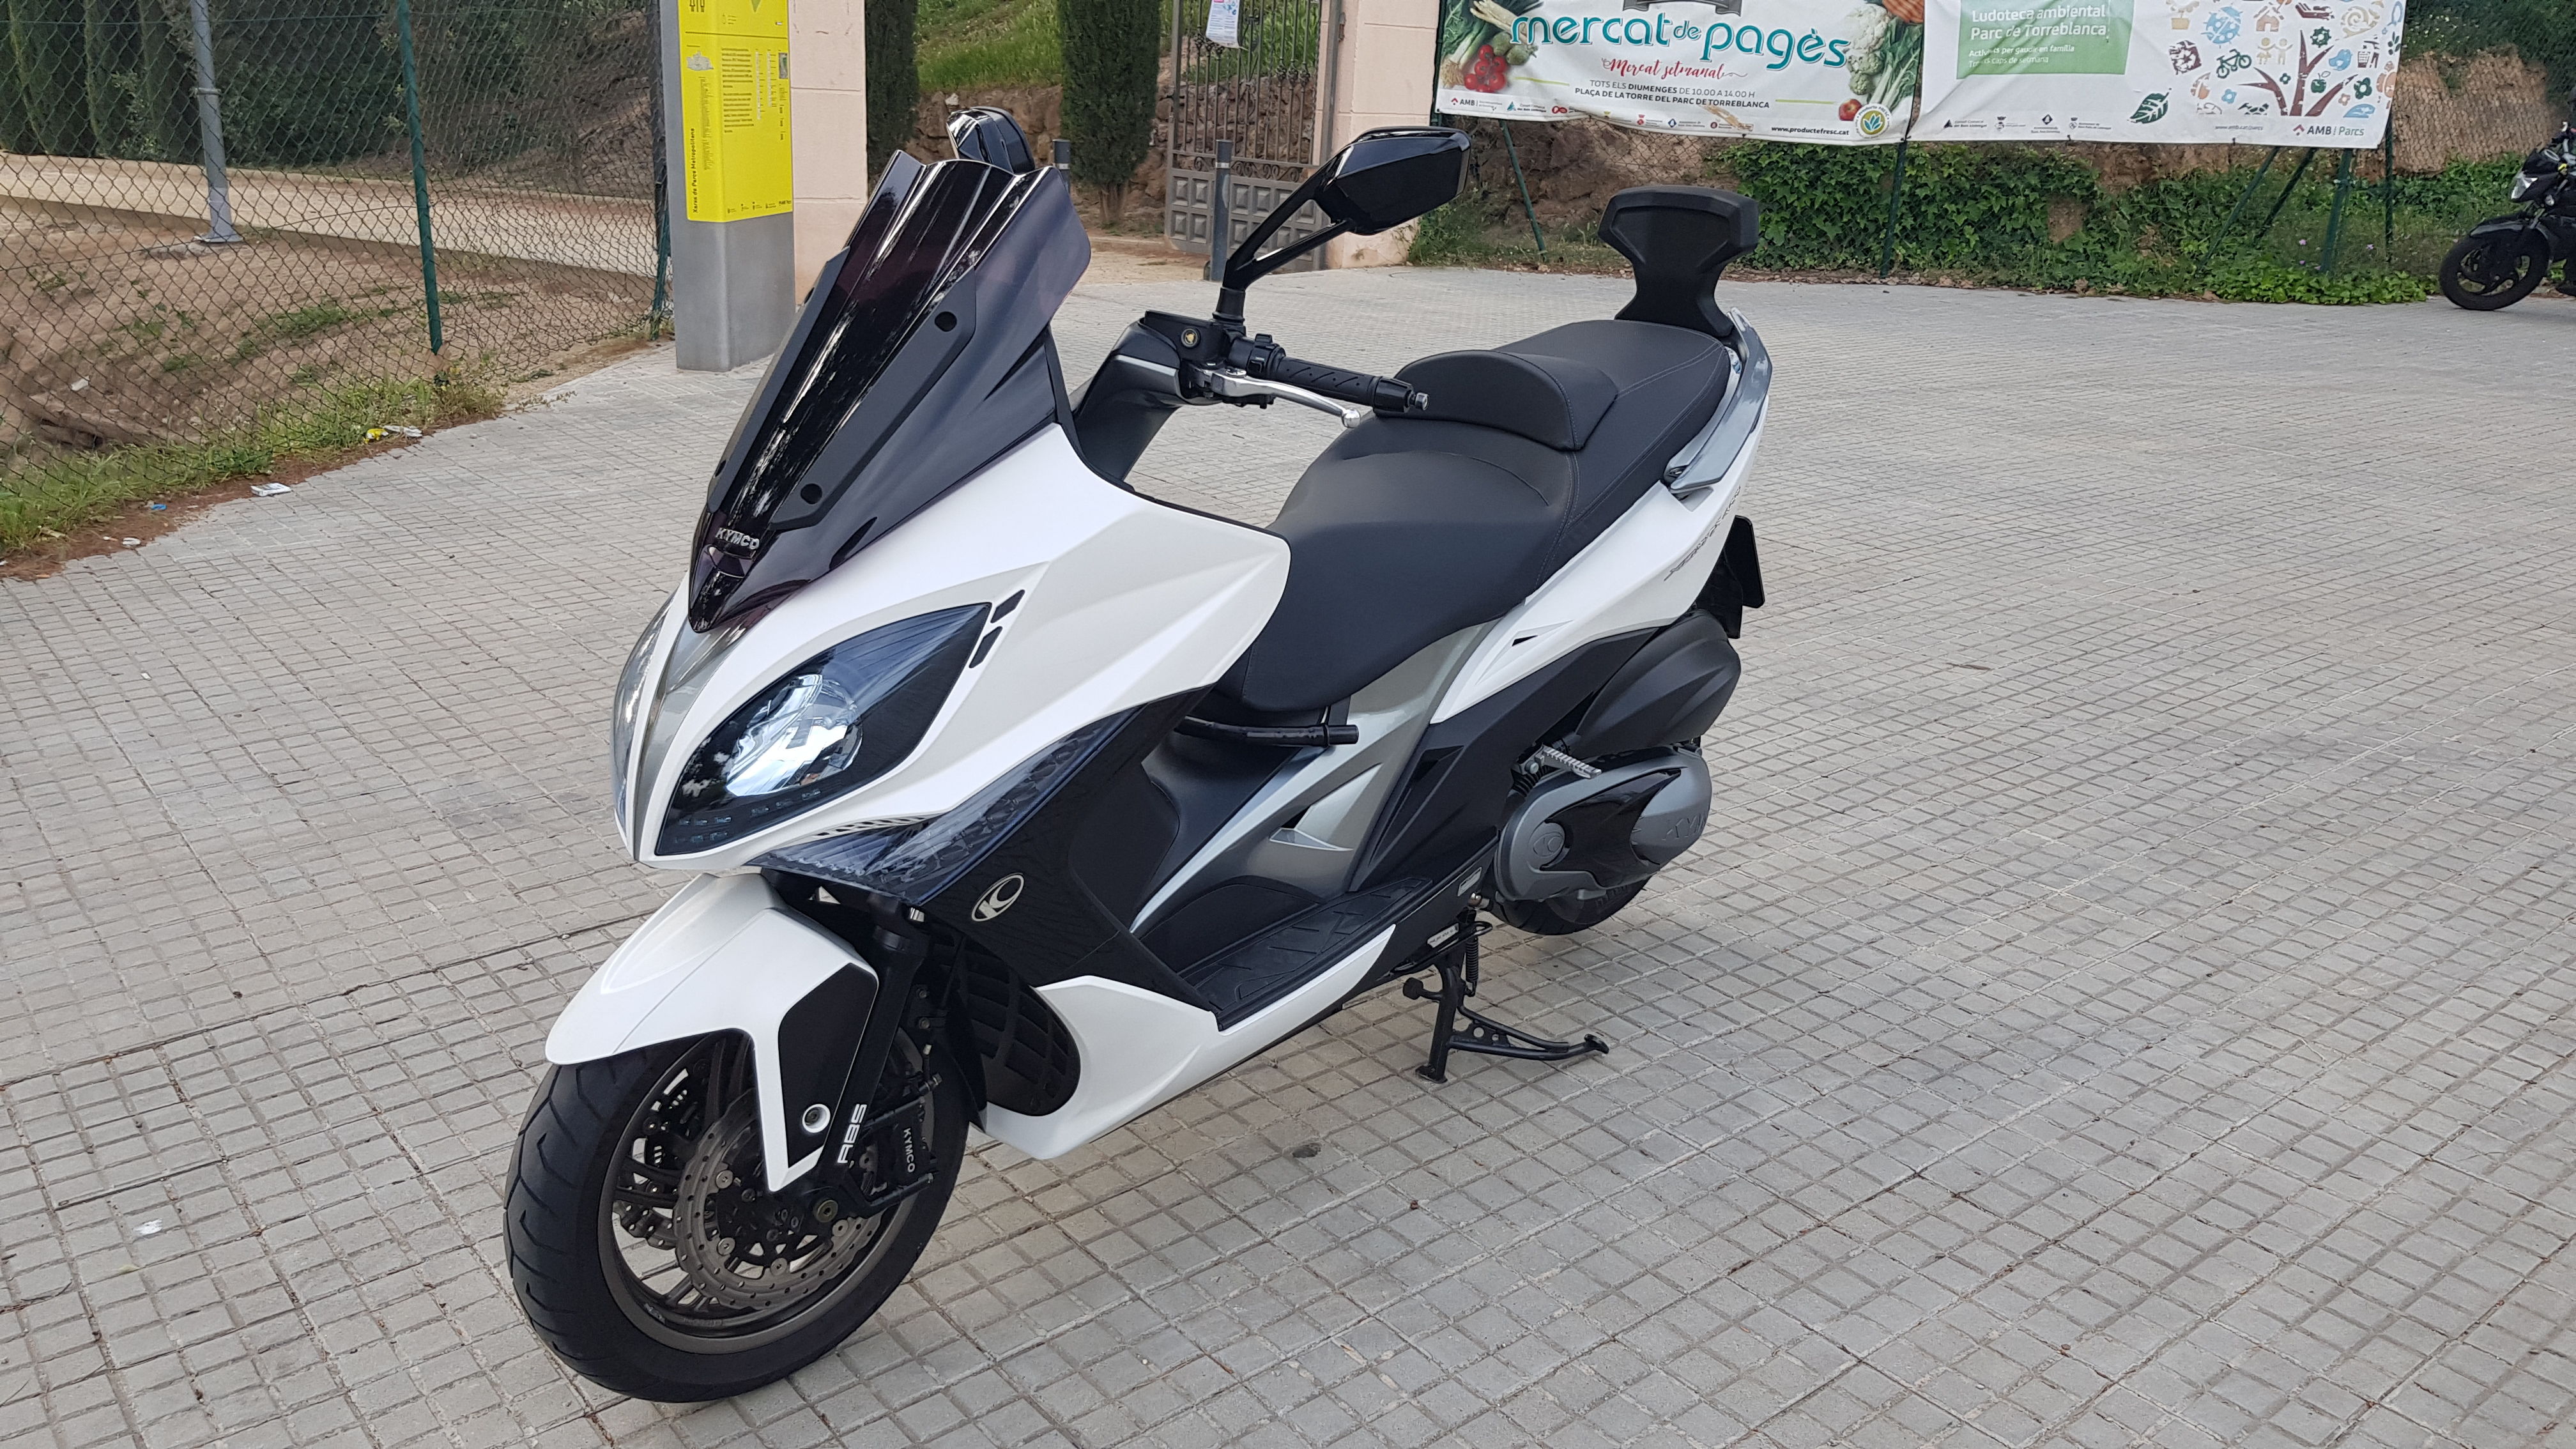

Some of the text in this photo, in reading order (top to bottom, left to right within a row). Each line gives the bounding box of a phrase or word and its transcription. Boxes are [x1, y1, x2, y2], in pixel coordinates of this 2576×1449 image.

[1972, 4, 2106, 22] Ludoteca ambiental
[1512, 12, 1850, 70] mercat de pagès
[1970, 22, 2106, 40] Parc de Torreblanca
[1602, 58, 1726, 80] Mercat setmanal
[1590, 80, 1611, 88] TOTS
[1612, 81, 1627, 89] ELS
[1628, 84, 1678, 93] DIUMENGES
[1575, 88, 1600, 97] PLAÇA
[1625, 93, 1653, 101] TORRE
[1673, 96, 1694, 105] PARC
[1707, 99, 1770, 109] TORREBLANCA
[1771, 126, 1850, 135] www.productefresc.cat
[2306, 125, 2365, 136] AMB Parcs
[714, 527, 760, 550] KYMCO
[837, 1103, 868, 1164] ABS
[903, 1127, 916, 1173] KYMCO
